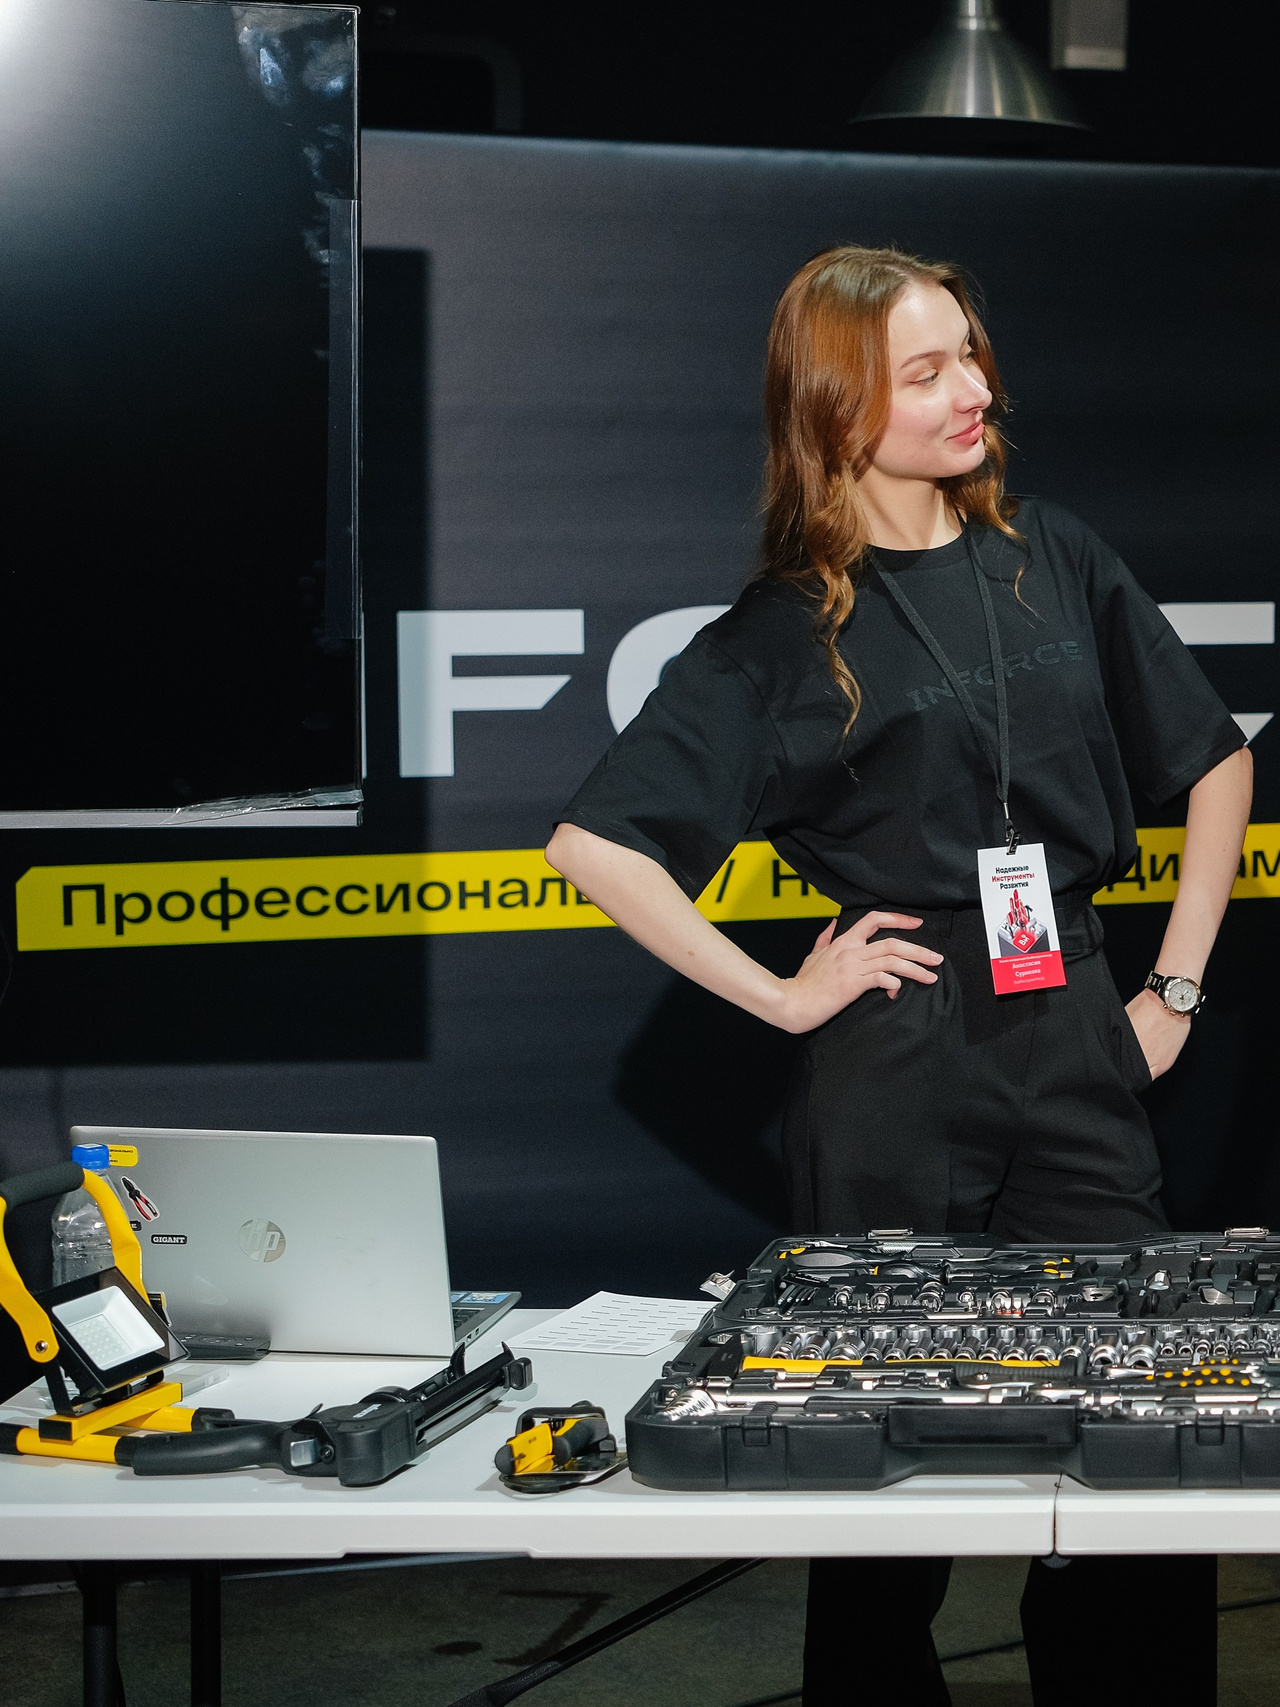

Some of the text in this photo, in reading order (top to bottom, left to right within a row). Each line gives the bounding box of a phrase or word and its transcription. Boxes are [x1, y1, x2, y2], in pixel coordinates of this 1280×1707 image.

[995, 865, 1030, 874] Надежные
[991, 872, 1035, 883] Инструменты
[999, 881, 1029, 890] Развития
[61, 876, 593, 936] Профессионал
[152, 1236, 186, 1244] GIGANT
